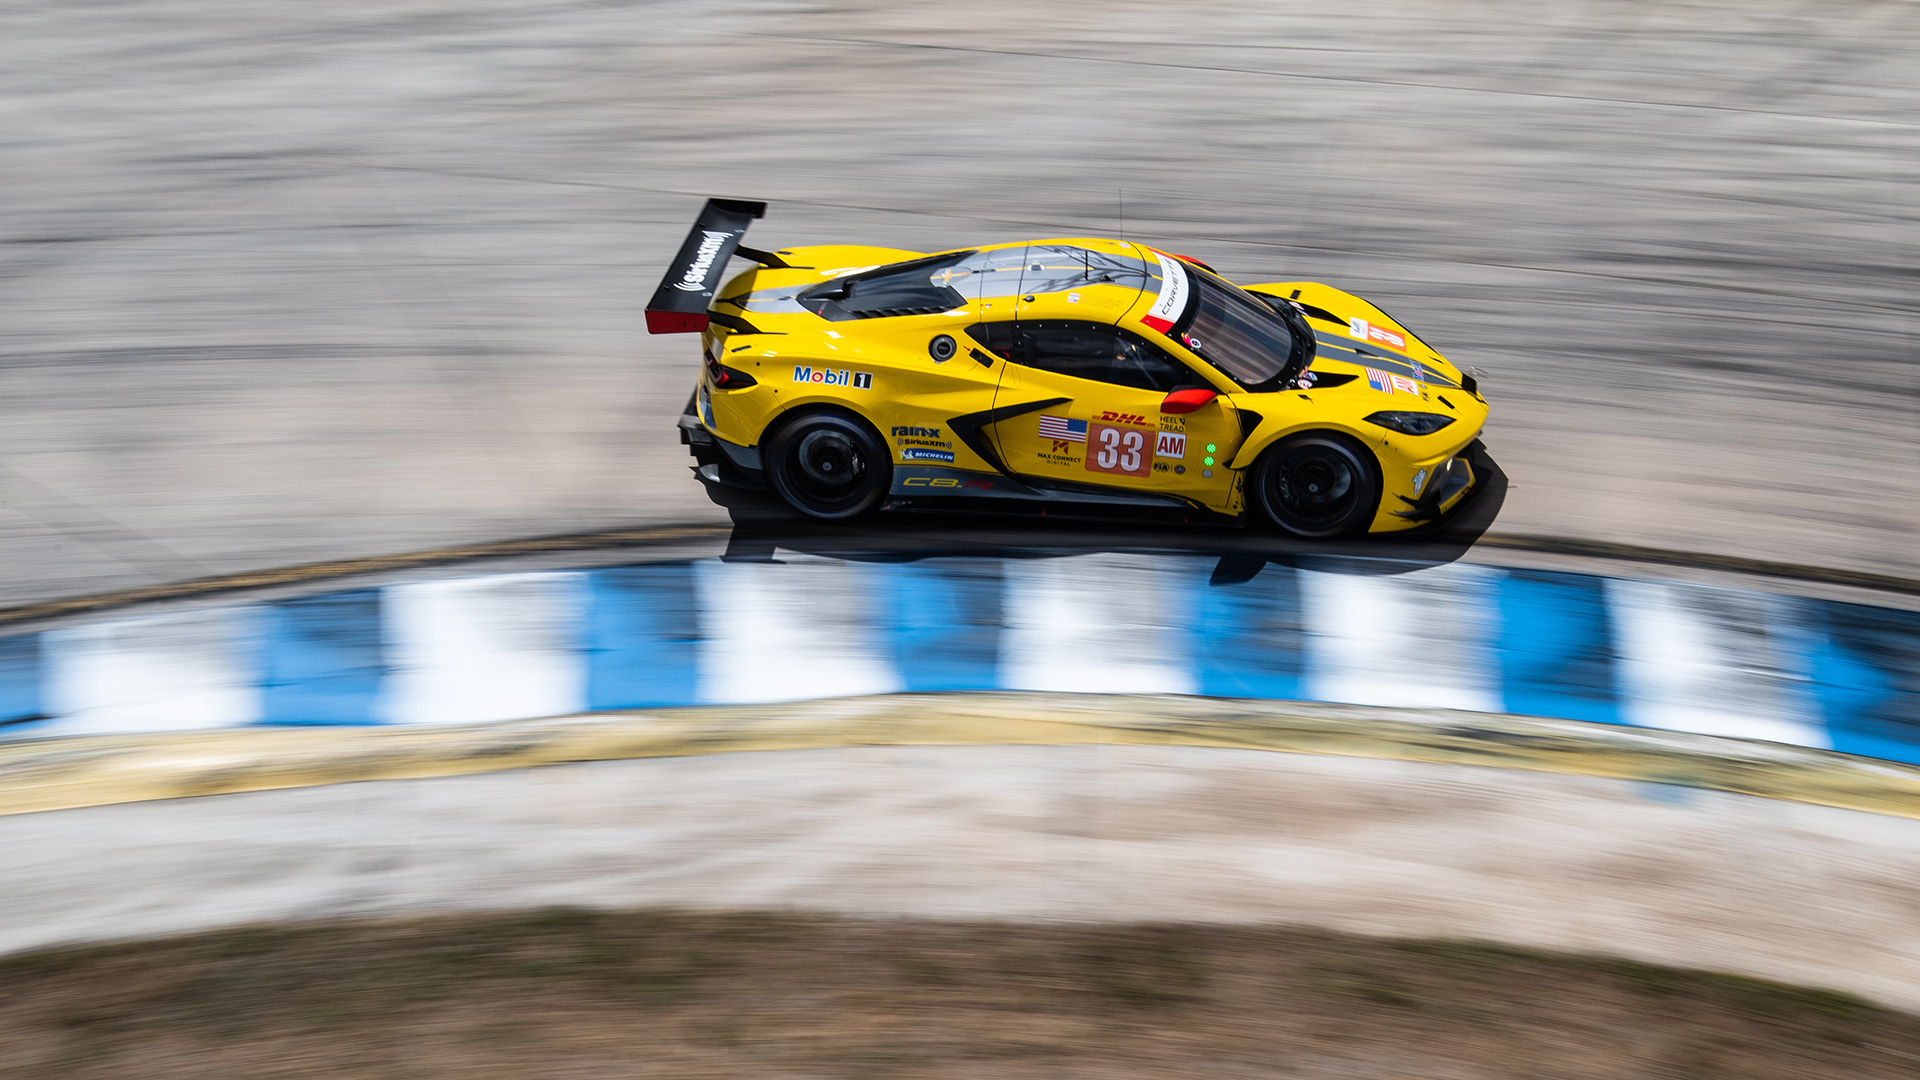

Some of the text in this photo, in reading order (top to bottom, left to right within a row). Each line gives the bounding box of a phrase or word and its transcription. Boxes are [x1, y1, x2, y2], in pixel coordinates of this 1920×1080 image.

[793, 366, 850, 386] Mobil
[1101, 411, 1147, 426] DHL
[1160, 416, 1178, 424] HEEL
[1160, 423, 1184, 432] TREAD
[1097, 428, 1144, 472] 33
[1157, 436, 1184, 455] AM
[914, 452, 954, 461] MICHELIN
[1052, 454, 1081, 463] CONNECT
[903, 477, 995, 491] C8.R
